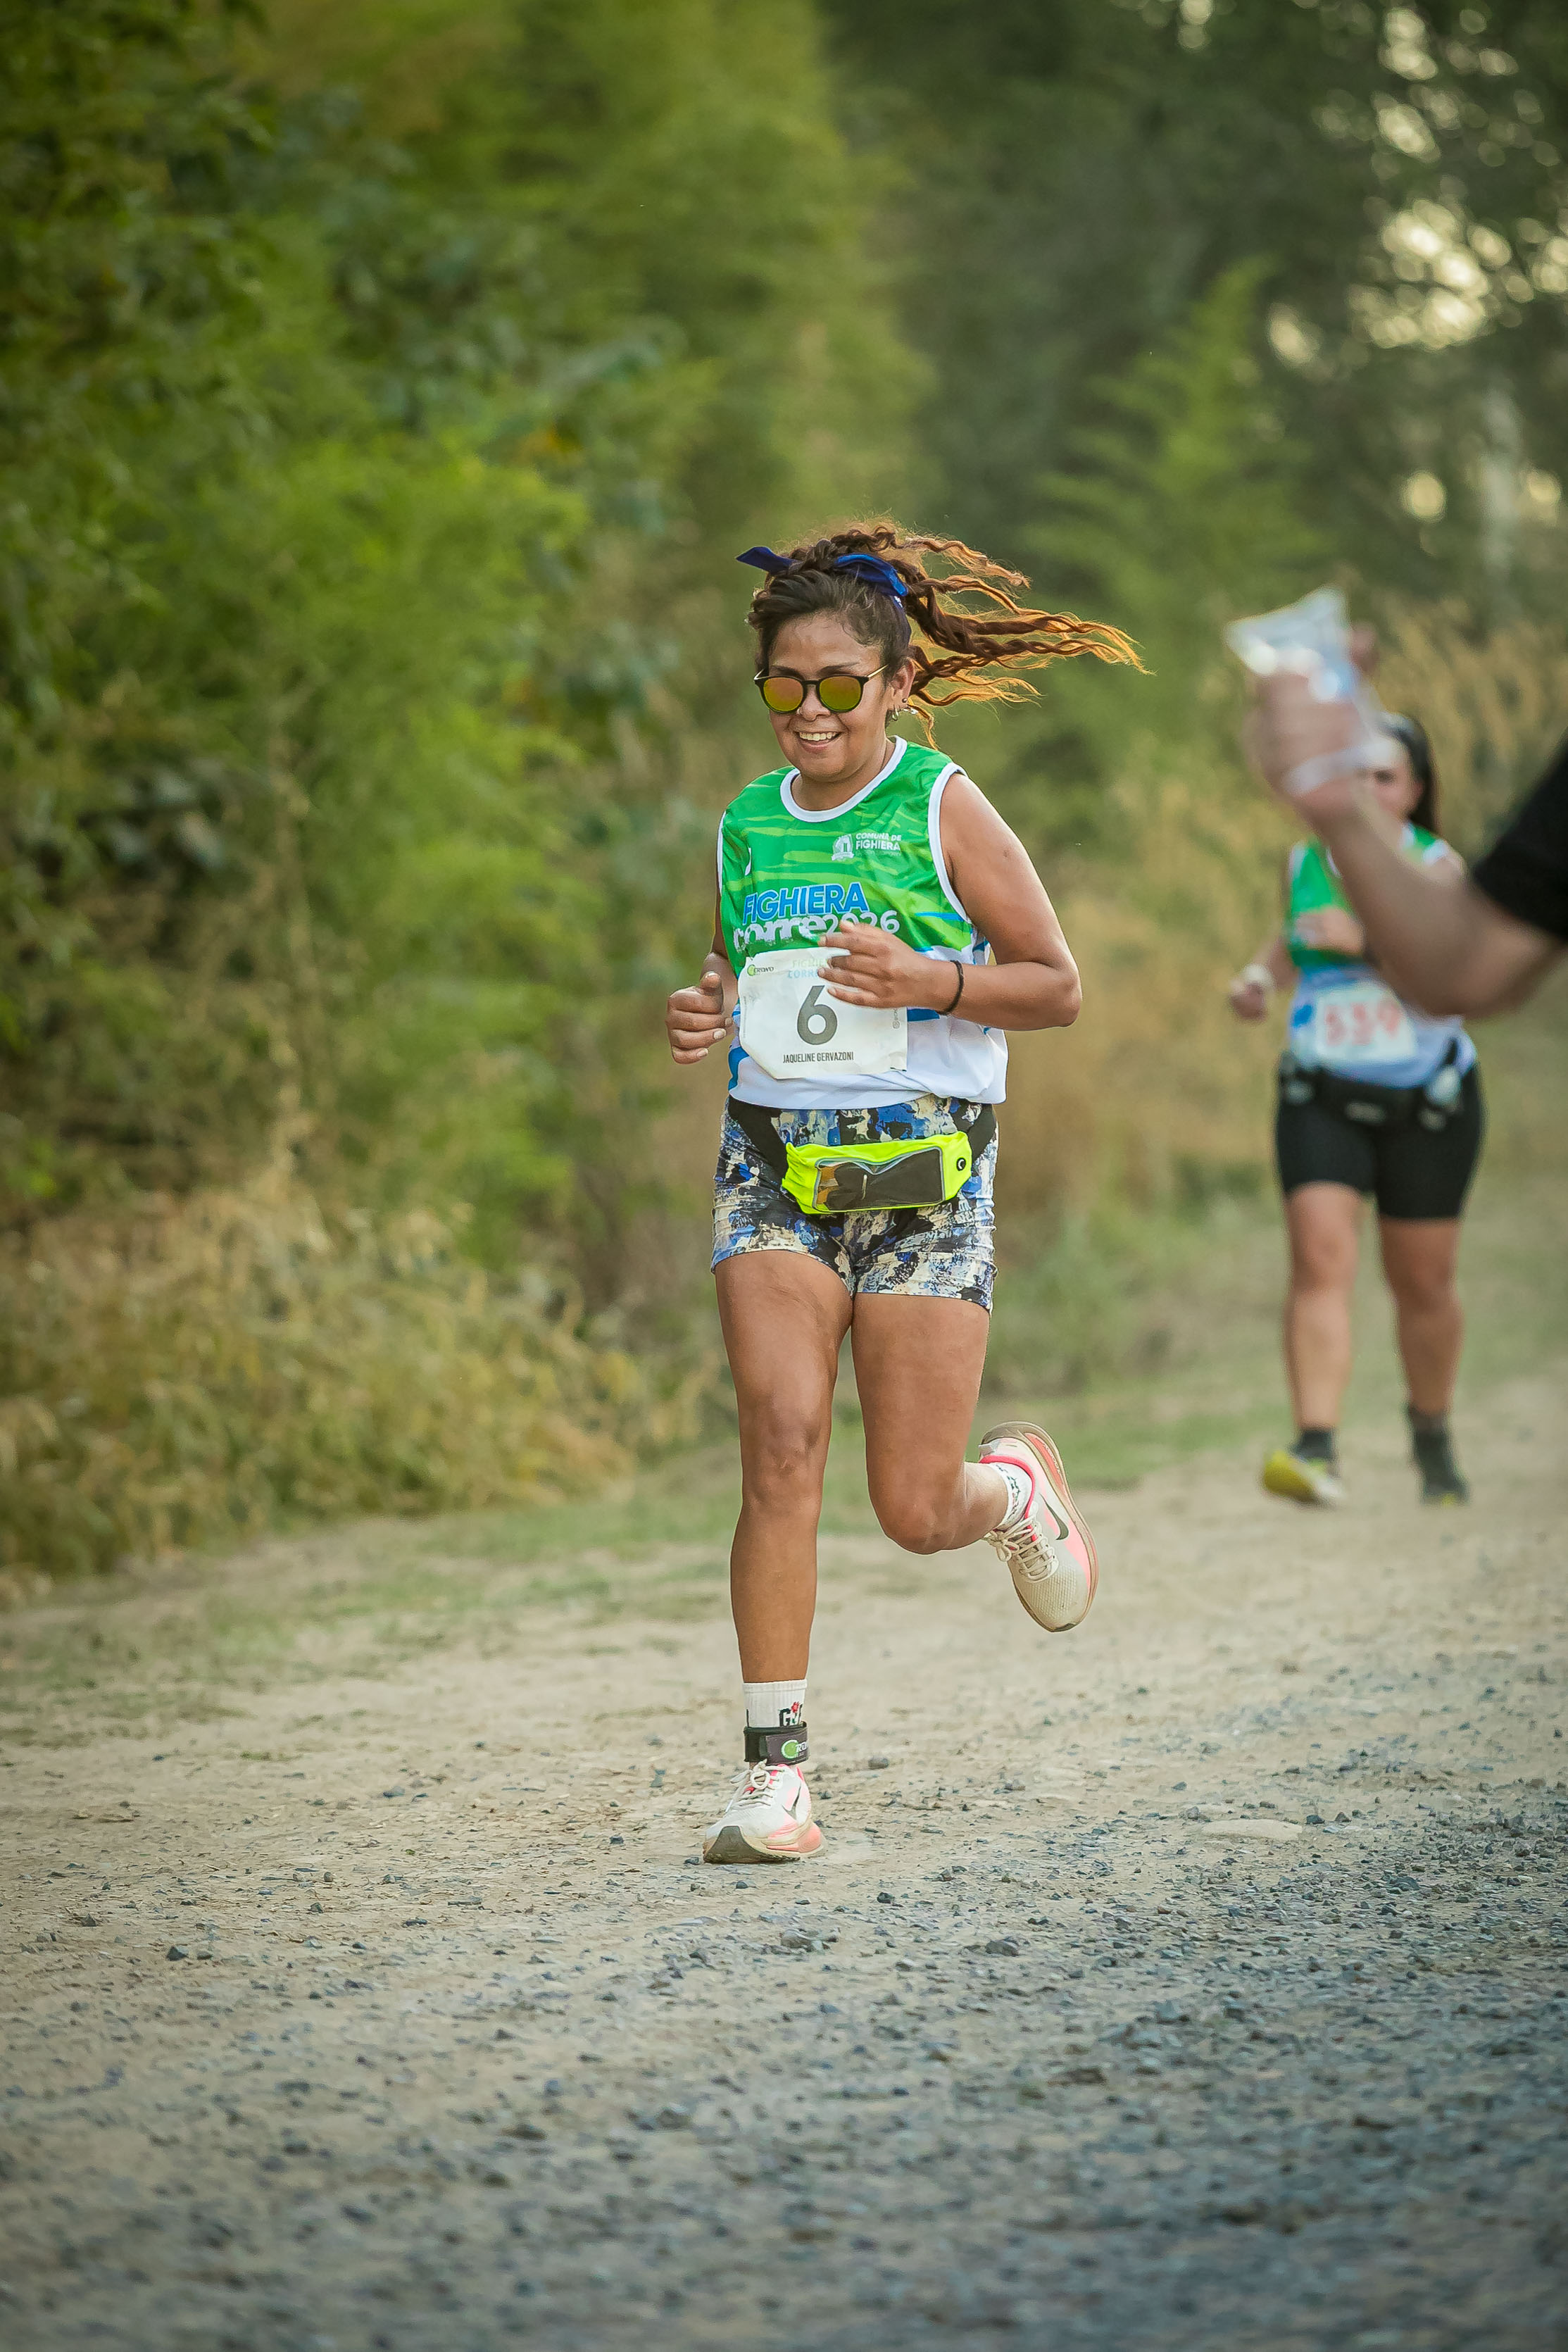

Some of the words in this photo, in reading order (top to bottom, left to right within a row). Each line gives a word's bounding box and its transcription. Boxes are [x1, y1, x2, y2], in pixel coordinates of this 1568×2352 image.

[855, 832, 890, 841] COMUNA
[855, 839, 901, 851] FIGHIERA
[743, 882, 870, 926] FIGHIERA
[792, 958, 828, 968] FIGHIE
[788, 968, 818, 979] CORR
[797, 984, 838, 1046] 6
[782, 1053, 816, 1064] JAQUELINE
[816, 1051, 854, 1062] GERVAZONI
